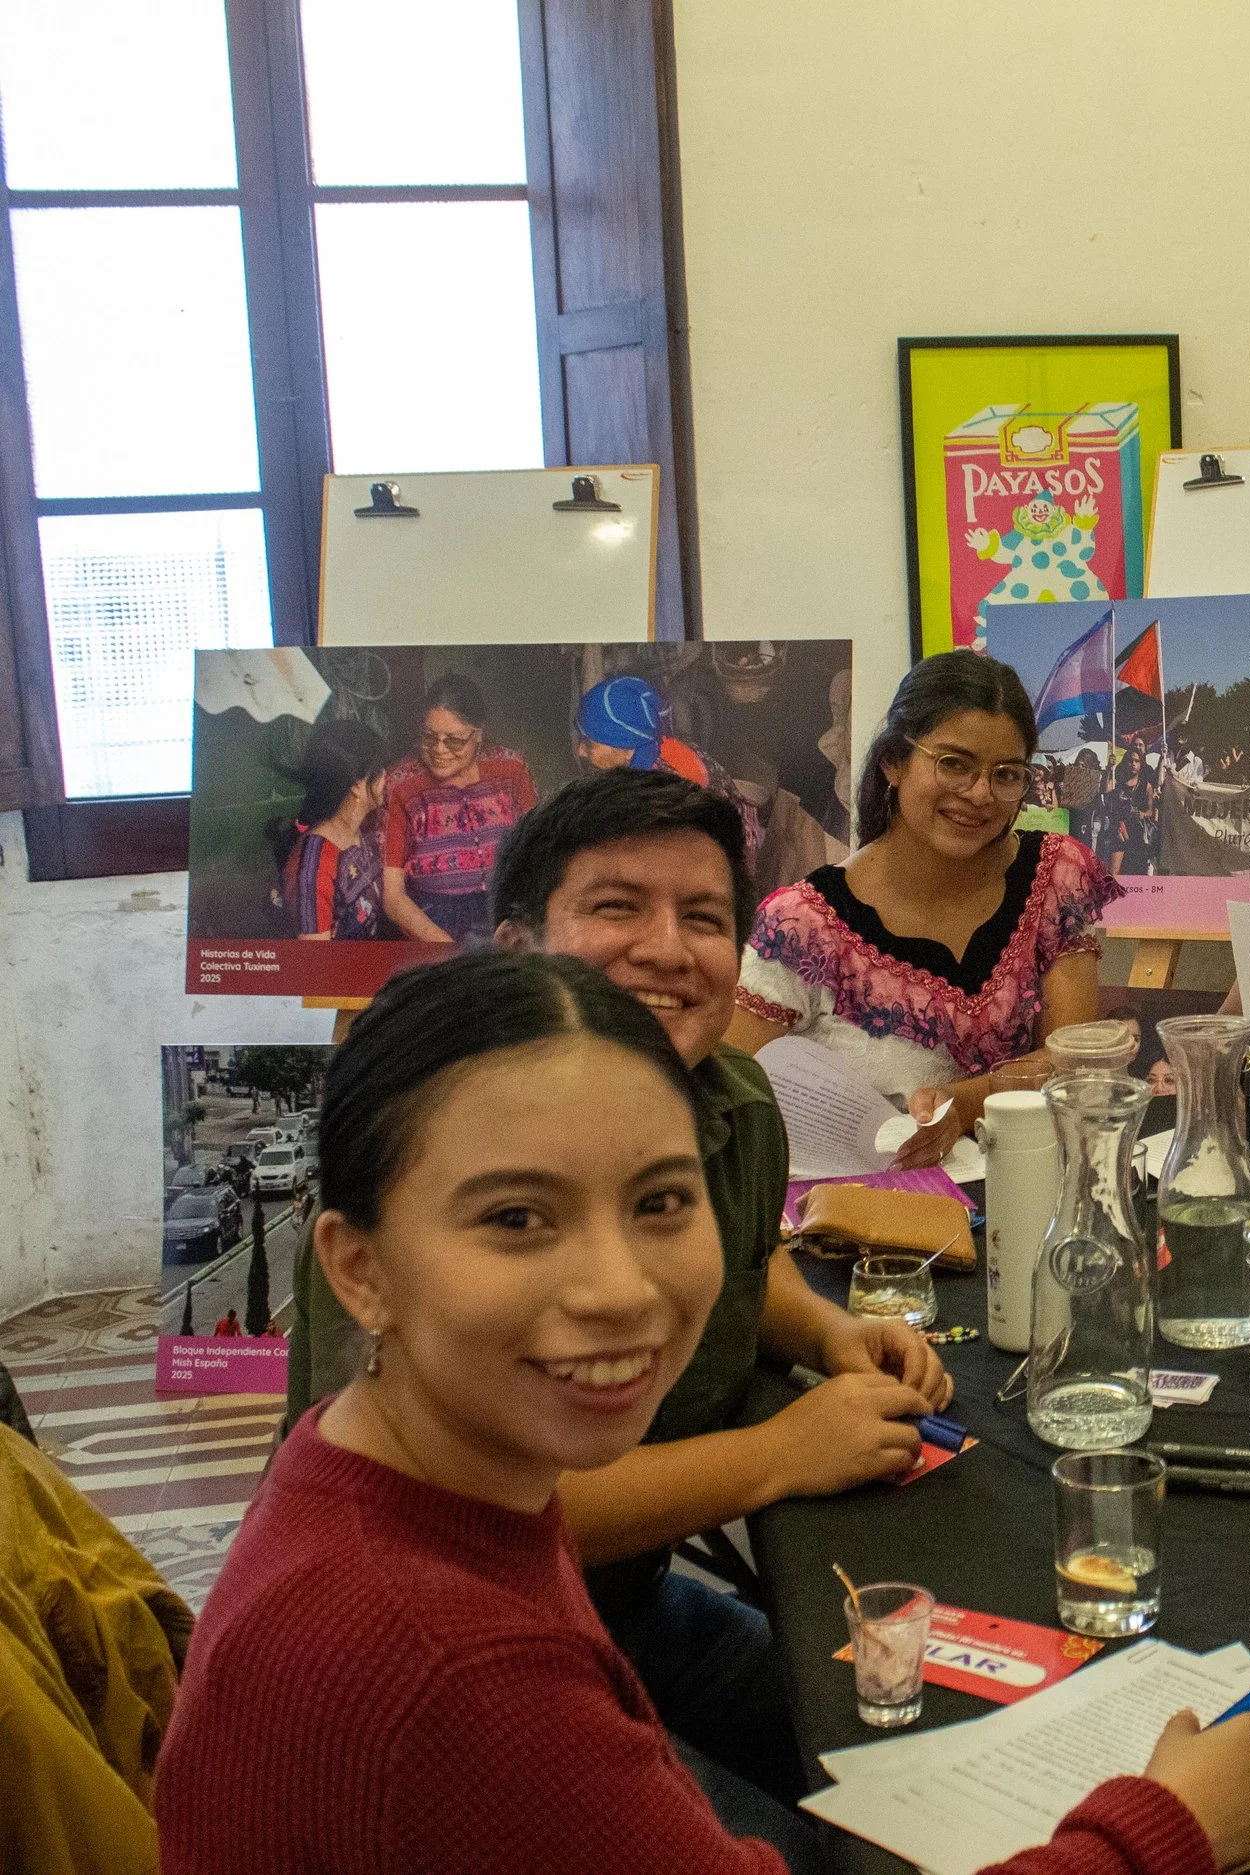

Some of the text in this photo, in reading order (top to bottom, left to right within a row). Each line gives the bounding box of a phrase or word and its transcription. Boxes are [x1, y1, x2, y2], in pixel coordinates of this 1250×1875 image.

[962, 457, 1104, 522] PAYASOS
[200, 949, 276, 959] Historias de Vida
[200, 961, 242, 971] Colectiva
[200, 973, 221, 983] 2025
[173, 1346, 205, 1356] Bloque
[206, 1346, 272, 1357] Independiente
[172, 1358, 228, 1368] Mish España
[171, 1370, 193, 1380] 2025
[926, 1644, 1007, 1673] LAR
